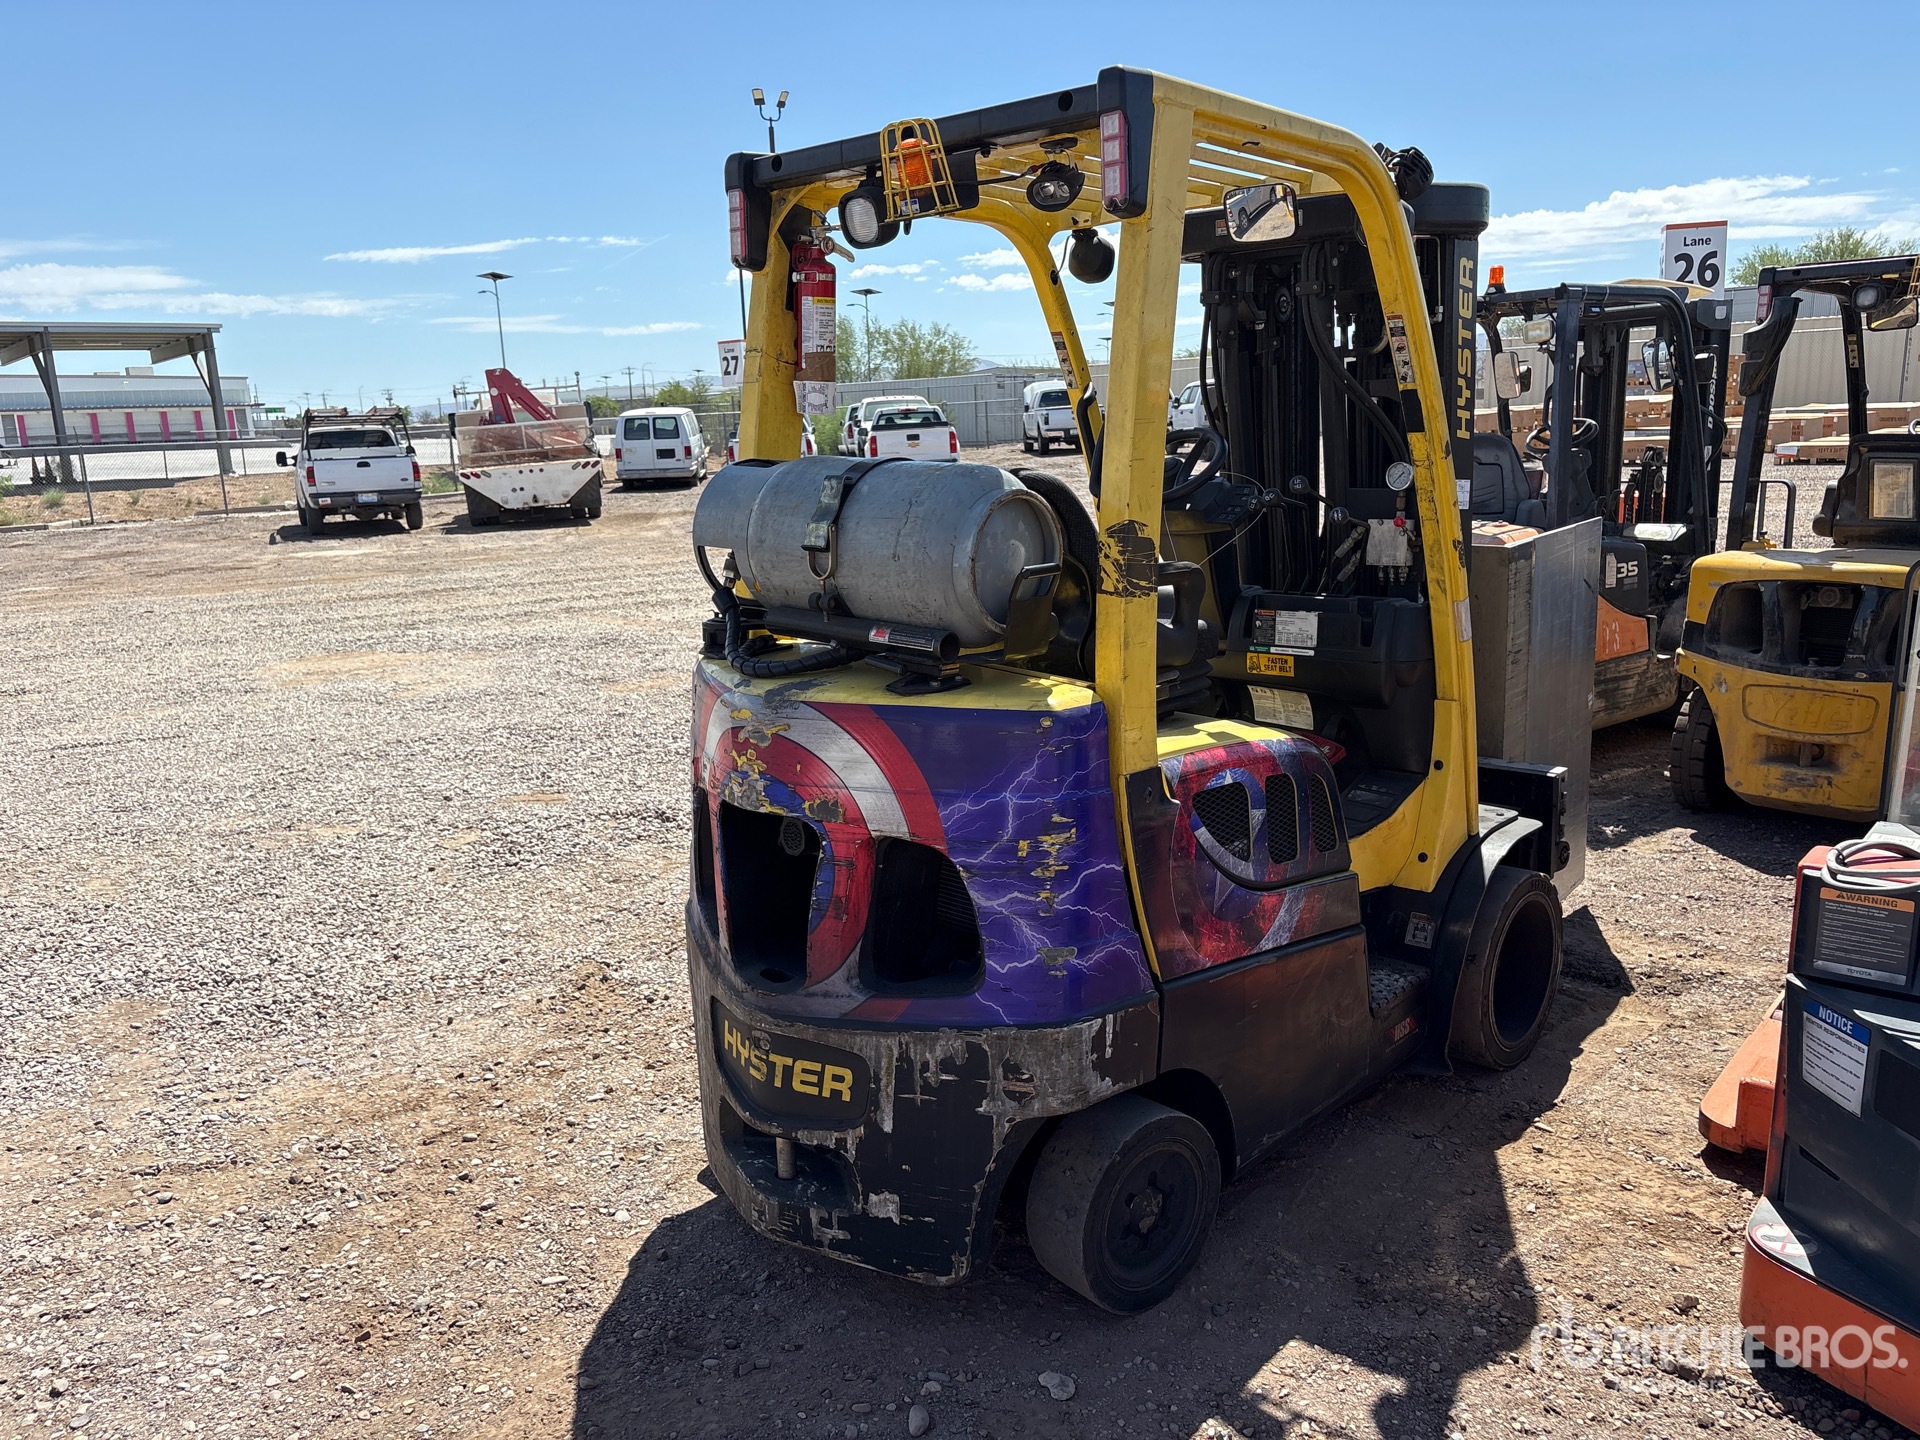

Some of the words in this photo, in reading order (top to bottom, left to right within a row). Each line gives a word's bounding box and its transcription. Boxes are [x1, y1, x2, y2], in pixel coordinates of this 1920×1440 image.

[1683, 236, 1712, 247] Lane
[1674, 250, 1720, 288] 26
[1456, 256, 1474, 440] HYSTER
[722, 355, 739, 376] 27
[1617, 560, 1639, 578] 35
[1263, 664, 1278, 672] SEAT
[1278, 665, 1293, 673] BELT
[1267, 657, 1289, 666] FASTEN
[1845, 893, 1898, 908] WARNING
[1846, 967, 1872, 977] TOYOTA
[1818, 1005, 1854, 1035] NOTICE
[724, 1019, 853, 1102] HYSTER
